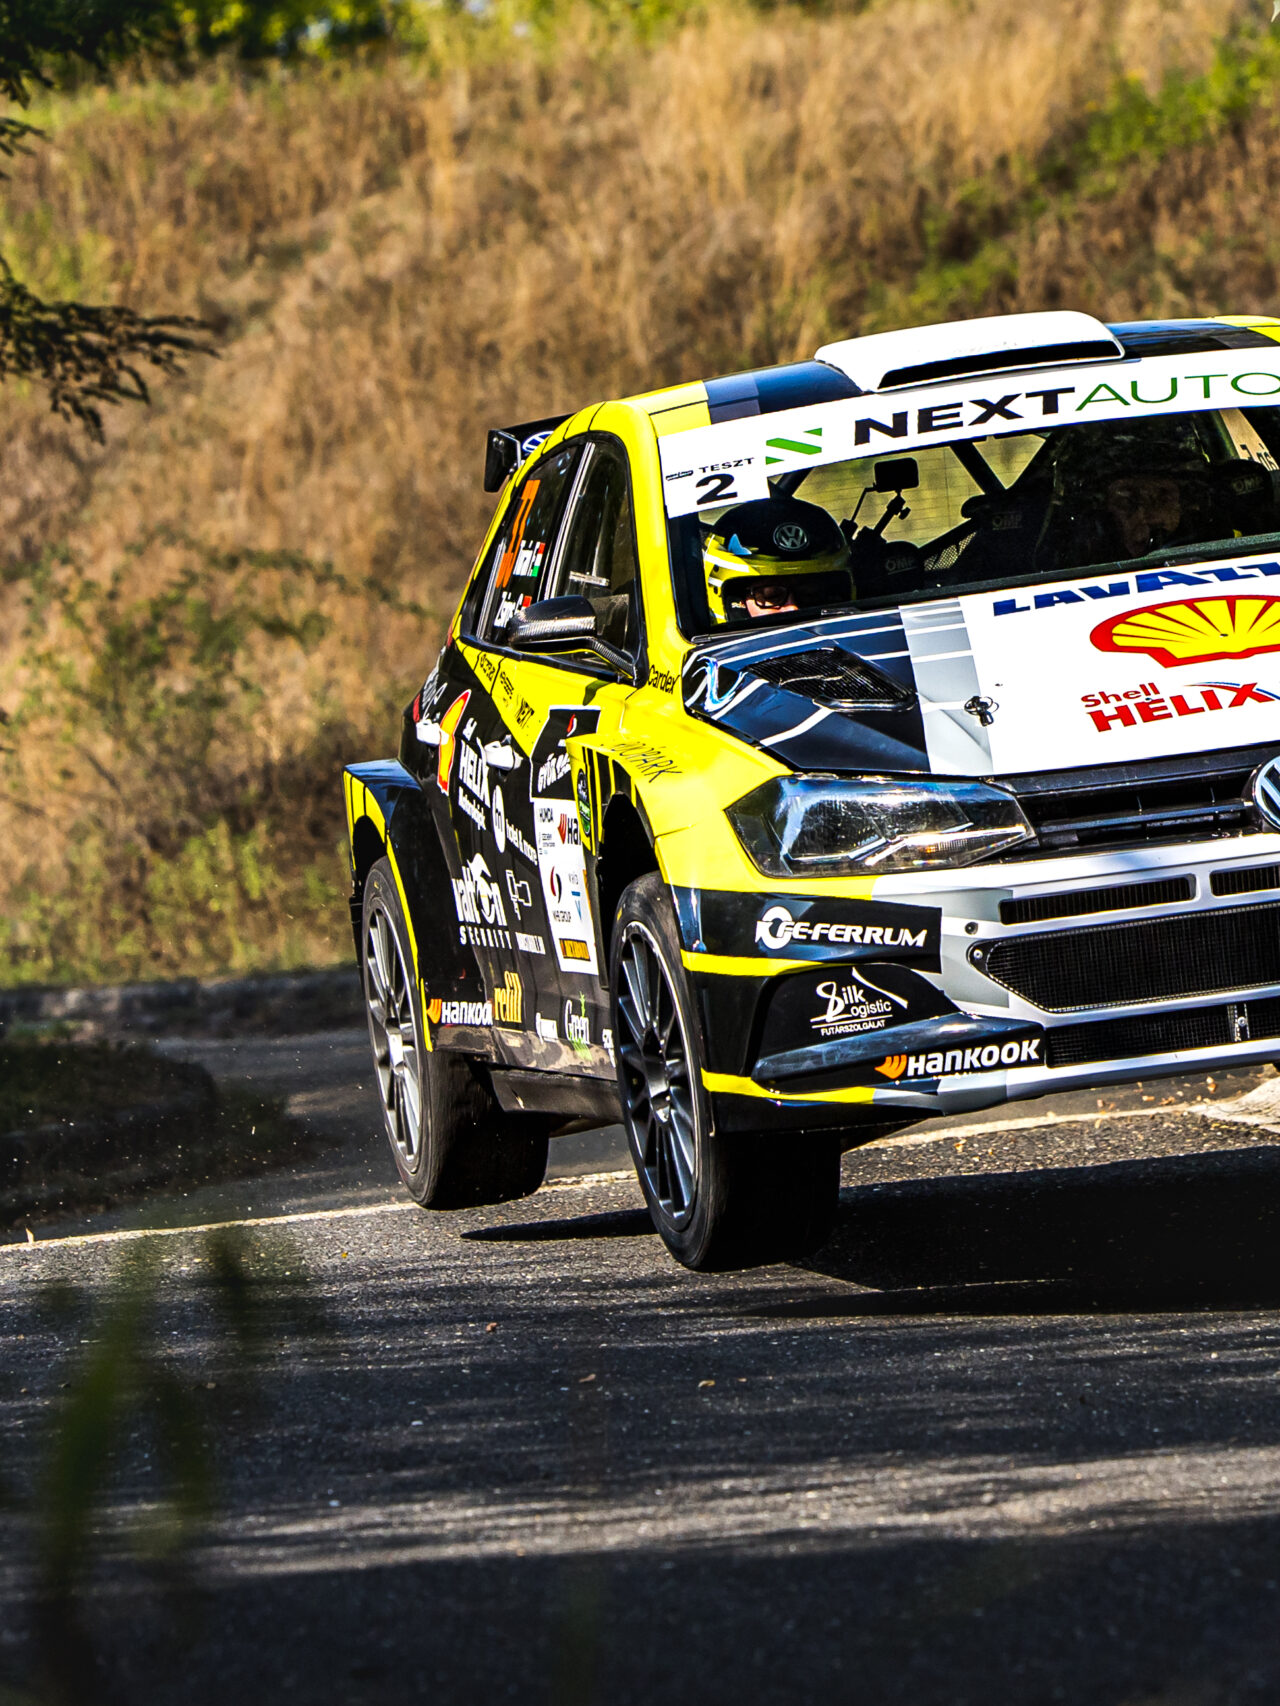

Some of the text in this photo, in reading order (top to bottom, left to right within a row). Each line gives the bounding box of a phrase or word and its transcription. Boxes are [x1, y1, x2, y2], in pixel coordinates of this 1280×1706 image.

[699, 457, 755, 473] TESZT
[695, 473, 738, 506] 2
[648, 665, 681, 695] Cardex
[1081, 682, 1160, 708] Shell
[1087, 682, 1276, 733] HELIX
[459, 925, 512, 949] SECURITY
[776, 918, 928, 948] FE-FERRUM
[494, 970, 523, 1024] refill
[820, 1019, 886, 1037] FUTÁRSZOLGÁLAT
